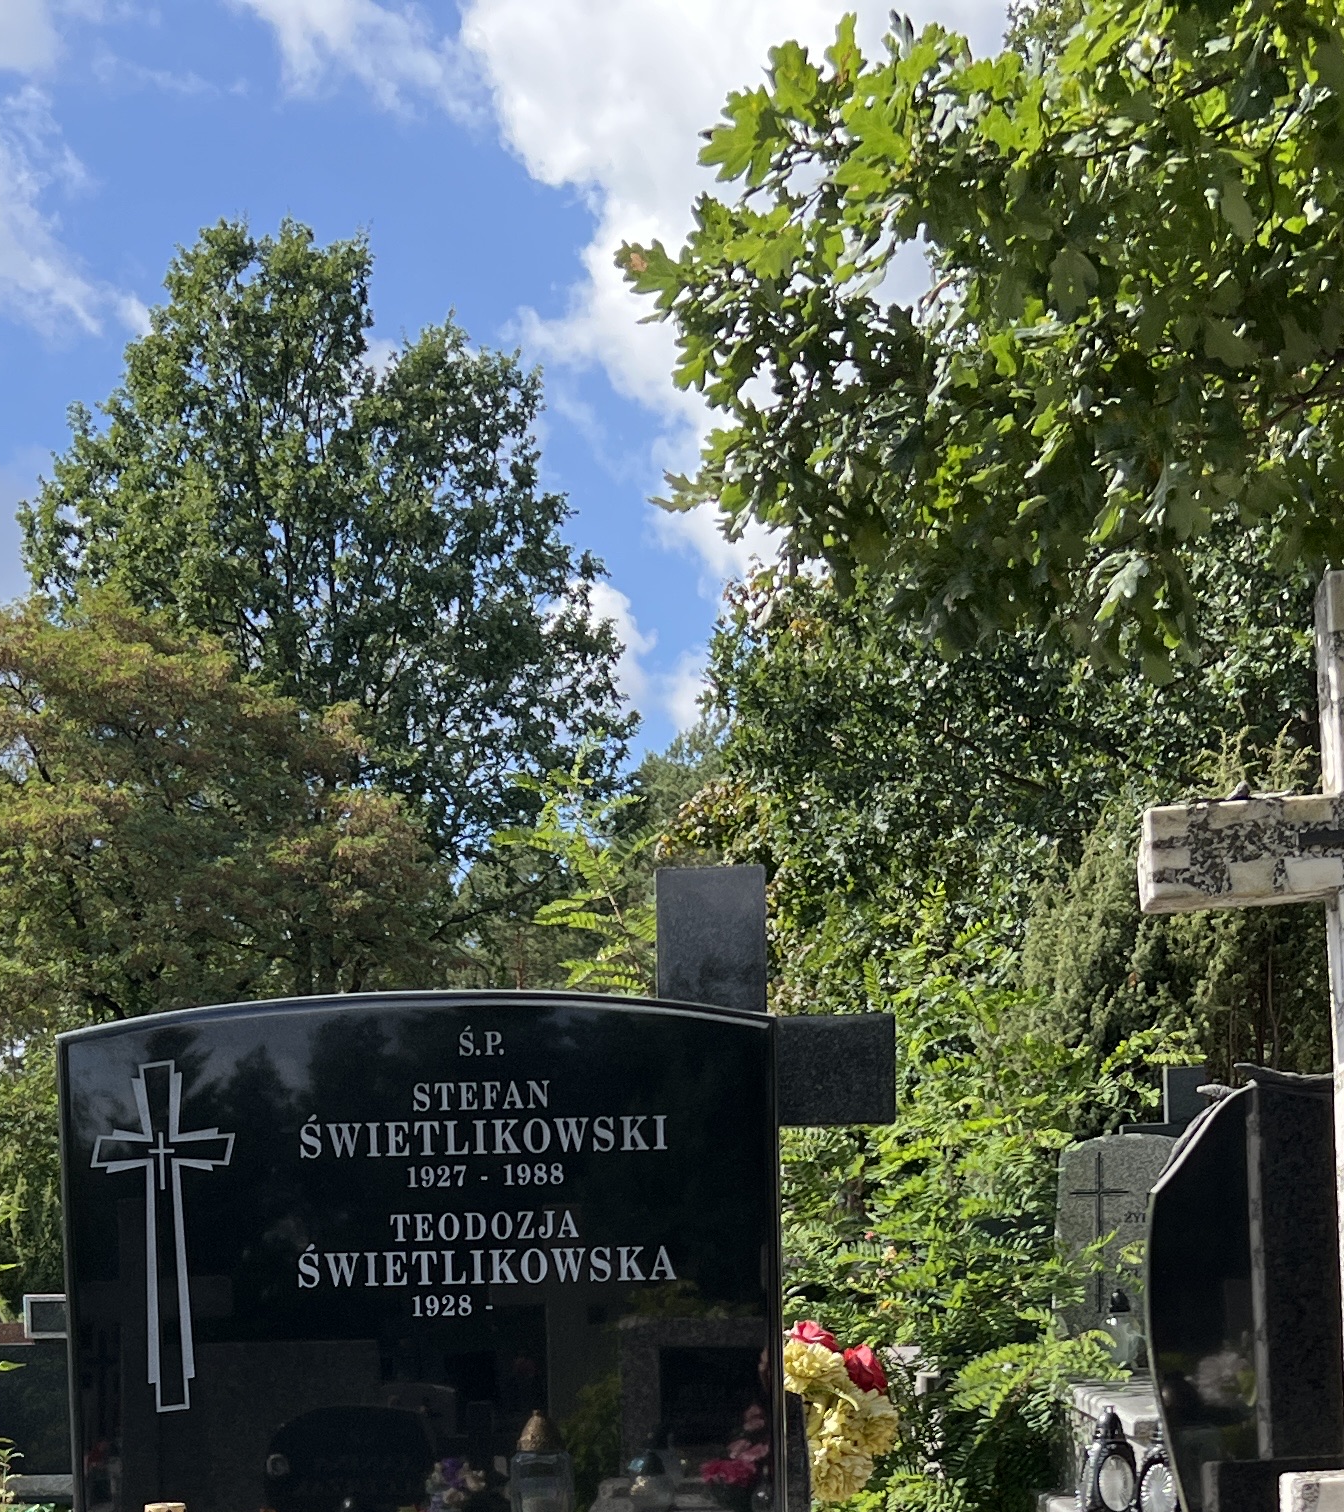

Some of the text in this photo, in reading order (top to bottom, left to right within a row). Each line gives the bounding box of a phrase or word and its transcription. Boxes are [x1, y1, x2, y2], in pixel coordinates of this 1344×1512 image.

[459, 1025, 504, 1057] Ś.P.
[412, 1080, 550, 1112] STEFAN
[299, 1113, 668, 1159] ŚWIETLIKOWSKI
[406, 1164, 467, 1188] 1927
[503, 1162, 565, 1186] 1988
[389, 1209, 580, 1242] TEODOZJA
[297, 1243, 678, 1289] ŚWIETLIKOWSKA
[411, 1294, 473, 1318] 1928
